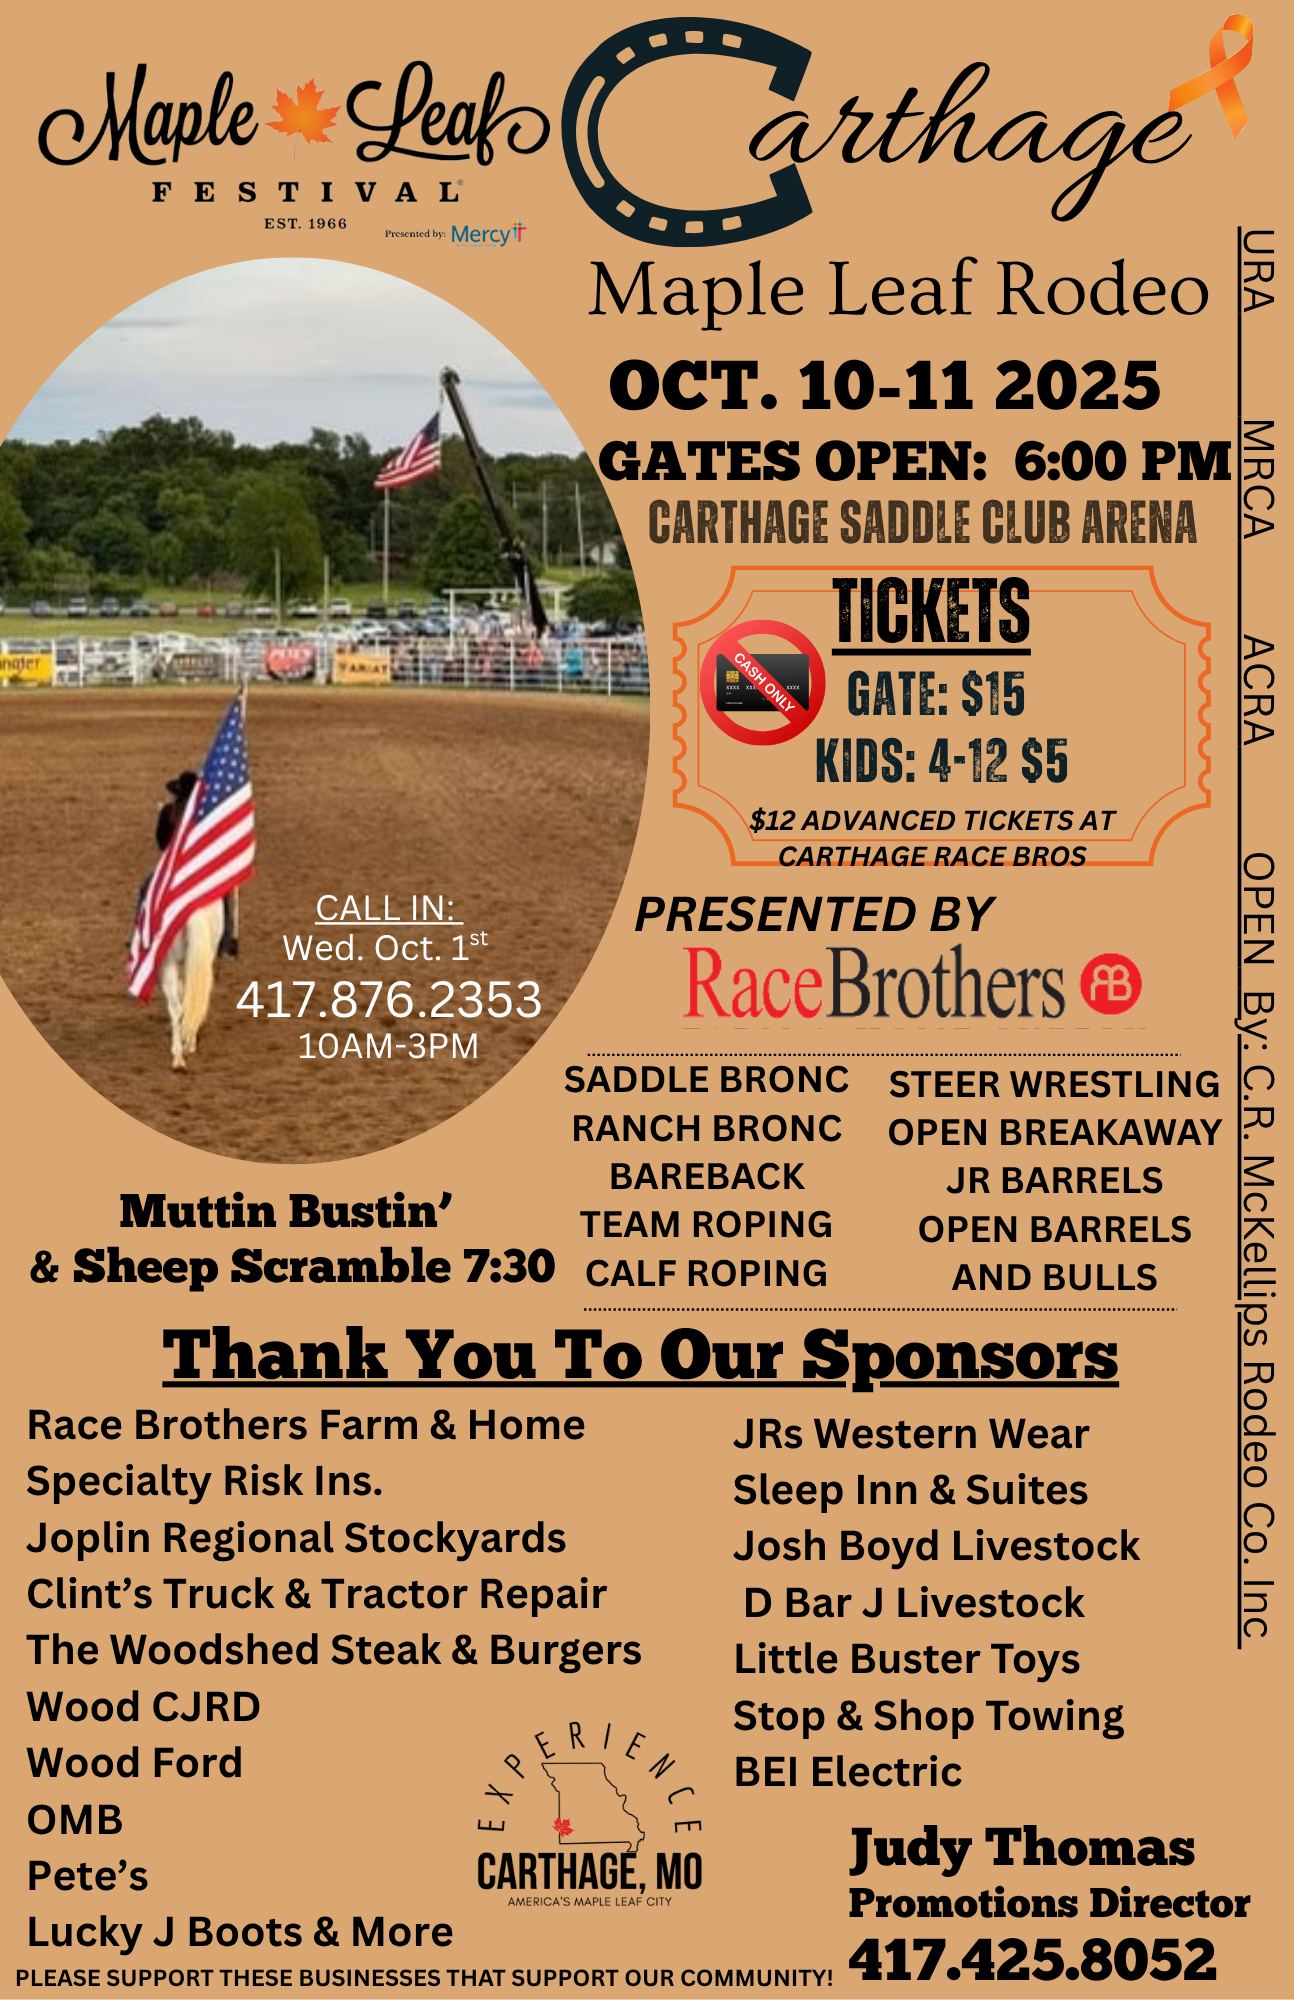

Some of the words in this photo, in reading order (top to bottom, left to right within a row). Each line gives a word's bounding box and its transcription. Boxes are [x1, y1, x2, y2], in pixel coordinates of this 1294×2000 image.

[38, 64, 259, 165] Maple
[347, 61, 550, 166] Leaf
[265, 218, 301, 229] EST.
[309, 218, 346, 229] 1966
[385, 229, 430, 237] Presented
[433, 229, 446, 239] by:
[452, 225, 510, 247] Mercy
[1244, 231, 1274, 312] URA
[589, 260, 803, 331] Maple
[829, 257, 977, 315] Leaf
[997, 259, 1208, 316] Rodeo
[610, 359, 777, 410] OCT.
[800, 360, 973, 410] 10-11
[996, 360, 1160, 410] 2025
[599, 440, 800, 481] GATES
[816, 440, 986, 481] OPEN:
[1015, 440, 1126, 481] 6:00
[1142, 441, 1231, 480] PM
[1244, 421, 1274, 539] MRCA
[649, 500, 828, 544] CARTHAGE
[841, 500, 970, 544] SADDLE
[983, 500, 1070, 544] CLUB
[1082, 500, 1197, 543] ARENA
[832, 577, 1029, 643] TICKETS
[735, 653, 767, 685] CASH
[765, 683, 796, 711] ONLY
[849, 671, 947, 716] GATE:
[962, 671, 1024, 716] $15
[1244, 634, 1274, 745] ACRA
[817, 738, 914, 783] KIDS:
[929, 738, 1007, 782] 4-12
[1022, 737, 1067, 783] $5
[749, 807, 795, 833] $12
[801, 810, 955, 830] ADVANCED
[965, 810, 1074, 830] TICKETS
[1079, 811, 1117, 830] AT
[779, 846, 928, 866] CARTHAGE
[934, 846, 1007, 866] RACE
[1013, 846, 1087, 866] BROS
[317, 895, 400, 920] CALL
[413, 896, 452, 920] IN:
[635, 896, 916, 931] PRESENTED
[930, 897, 997, 931] BY
[1244, 853, 1275, 963] OPEN
[283, 934, 362, 960] Wed.
[376, 935, 440, 960] Oct.
[237, 981, 541, 1017] 417.876.2353
[1234, 993, 1274, 1049] By:
[300, 1033, 476, 1058] 10AM-3PM
[565, 1066, 708, 1092] SADDLE
[721, 1066, 848, 1093] BRONC
[890, 1071, 999, 1097] STEER
[1010, 1071, 1218, 1097] WRESTLING
[1244, 1066, 1275, 1139] C.R.
[889, 1119, 986, 1146] OPEN
[1001, 1119, 1222, 1145] BREAKAWAY
[612, 1163, 805, 1189] BAREBACK
[947, 1167, 990, 1194] JR
[1003, 1167, 1162, 1193] BARRELS
[120, 1192, 276, 1228] Muttin
[290, 1192, 452, 1228] Bustin’
[580, 1211, 679, 1237] TEAM
[694, 1211, 831, 1238] ROPING
[30, 1250, 58, 1283] &
[74, 1247, 218, 1292] Sheep
[231, 1247, 451, 1283] Scramble
[464, 1248, 555, 1283] 7:30
[1235, 1157, 1276, 1346] McKellips
[163, 1326, 388, 1379] Thank
[406, 1329, 536, 1379] You
[555, 1329, 642, 1379] To
[661, 1328, 783, 1379] Our
[803, 1328, 1118, 1391] Sponsors
[29, 1410, 121, 1440] Race
[136, 1408, 307, 1440] Brothers
[321, 1410, 417, 1439] Farm
[431, 1409, 456, 1439] &
[470, 1410, 584, 1440] Home
[733, 1419, 802, 1449] JRs
[814, 1419, 976, 1449] Western
[989, 1419, 1090, 1448] Wear
[1244, 1363, 1276, 1487] Rodeo
[27, 1464, 211, 1504] Specialty
[225, 1464, 303, 1496] Risk
[316, 1466, 381, 1496] Ins.
[734, 1473, 843, 1513] Sleep
[858, 1475, 916, 1504] Inn
[930, 1474, 955, 1504] &
[967, 1473, 1087, 1505] Suites
[26, 1521, 149, 1561] Joplin
[165, 1521, 333, 1561] Regional
[345, 1521, 565, 1561] Stockyards
[733, 1529, 825, 1561] Josh
[841, 1529, 937, 1569] Boyd
[954, 1529, 1140, 1561] Livestock
[1244, 1503, 1274, 1564] Co.
[28, 1577, 152, 1609] Clint’s
[163, 1577, 274, 1608] Truck
[285, 1578, 311, 1608] &
[321, 1579, 468, 1609] Tractor
[481, 1577, 607, 1617] Repair
[746, 1588, 771, 1617] D
[787, 1588, 852, 1617] Bar
[863, 1588, 882, 1617] J
[898, 1586, 1085, 1618] Livestock
[1244, 1581, 1274, 1637] Inc
[26, 1633, 98, 1665] The
[110, 1633, 317, 1665] Woodshed
[332, 1633, 441, 1665] Steak
[452, 1635, 477, 1664] &
[491, 1635, 641, 1673] Burgers
[736, 1642, 837, 1673] Little
[852, 1644, 980, 1674] Buster
[991, 1644, 1079, 1682] Toys
[734, 1700, 824, 1739] Stop
[837, 1700, 863, 1730] &
[874, 1699, 974, 1739] Shop
[986, 1699, 1124, 1739] Towing
[478, 1722, 702, 1833] EXPERIENCE
[28, 1805, 122, 1834] OMB
[850, 1825, 972, 1877] Judy
[985, 1825, 1195, 1866] Thomas
[29, 1860, 147, 1891] Pete’s
[478, 1852, 645, 1894] CARTHAGE,
[657, 1853, 702, 1889] MO
[508, 1896, 570, 1906] AMERICA'S
[574, 1897, 610, 1906] MAPLE
[616, 1897, 642, 1906] LEAF
[647, 1897, 672, 1906] CITY
[849, 1886, 1078, 1918] Promotions
[1090, 1886, 1250, 1918] Director
[29, 1915, 143, 1955] Lucky
[153, 1917, 173, 1946] J
[190, 1917, 302, 1947] Boots
[314, 1916, 339, 1946] &
[353, 1917, 452, 1947] More
[17, 1970, 100, 1986] PLEASE
[107, 1969, 213, 1986] SUPPORT
[220, 1970, 292, 1986] THESE
[300, 1969, 440, 1986] BUSINESSES
[447, 1970, 505, 1986] THAT
[512, 1969, 618, 1986] SUPPORT
[625, 1969, 674, 1986] OUR
[681, 1969, 832, 1986] COMMUNITY!
[849, 1938, 1216, 1981] 417.425.8052
